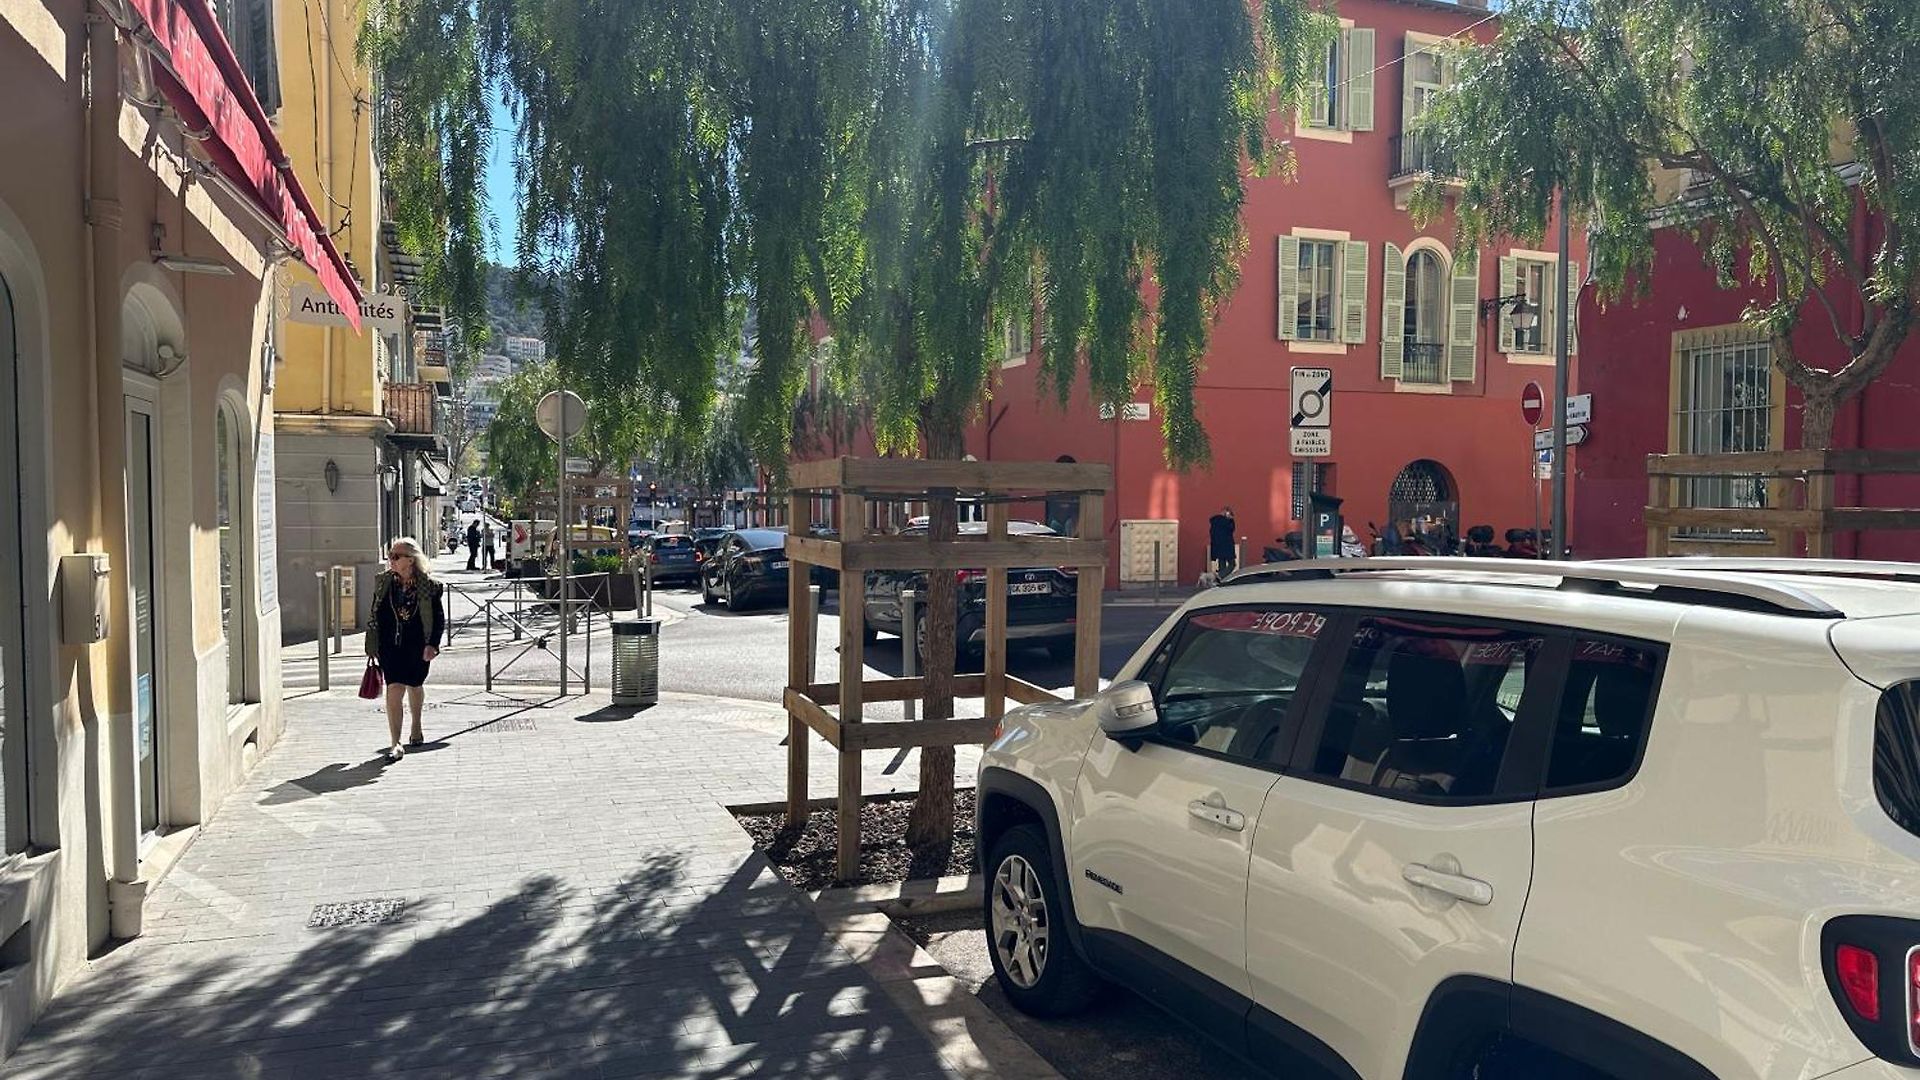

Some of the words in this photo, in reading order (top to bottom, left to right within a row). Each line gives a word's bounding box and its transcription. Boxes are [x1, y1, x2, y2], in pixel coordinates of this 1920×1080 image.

[301, 297, 395, 319] Antiités
[1320, 513, 1330, 527] P
[1085, 869, 1123, 895] RENEGADE
